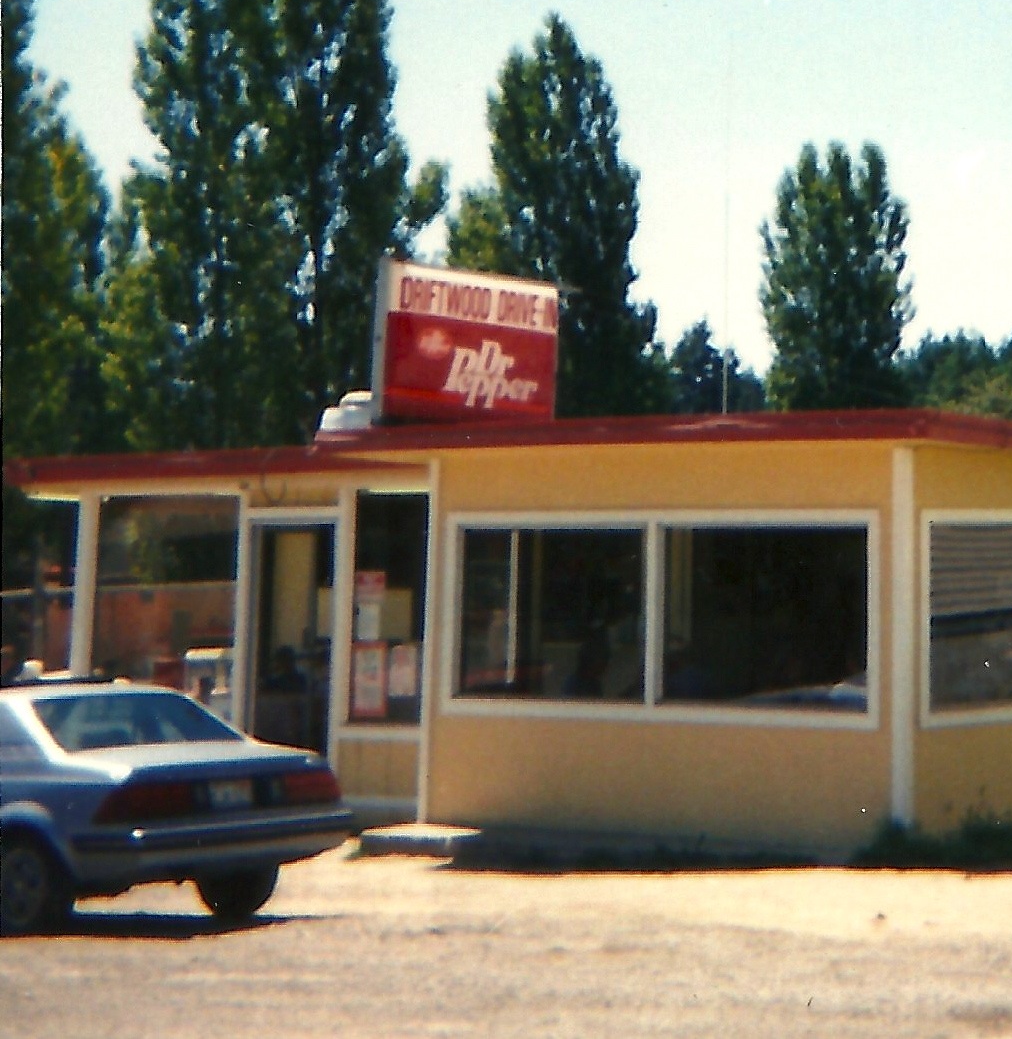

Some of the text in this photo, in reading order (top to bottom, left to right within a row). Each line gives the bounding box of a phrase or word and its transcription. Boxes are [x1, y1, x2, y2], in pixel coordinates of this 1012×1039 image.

[402, 277, 491, 319] DRIFTWOOD
[443, 347, 539, 408] Pepper
[480, 340, 514, 379] Dr
